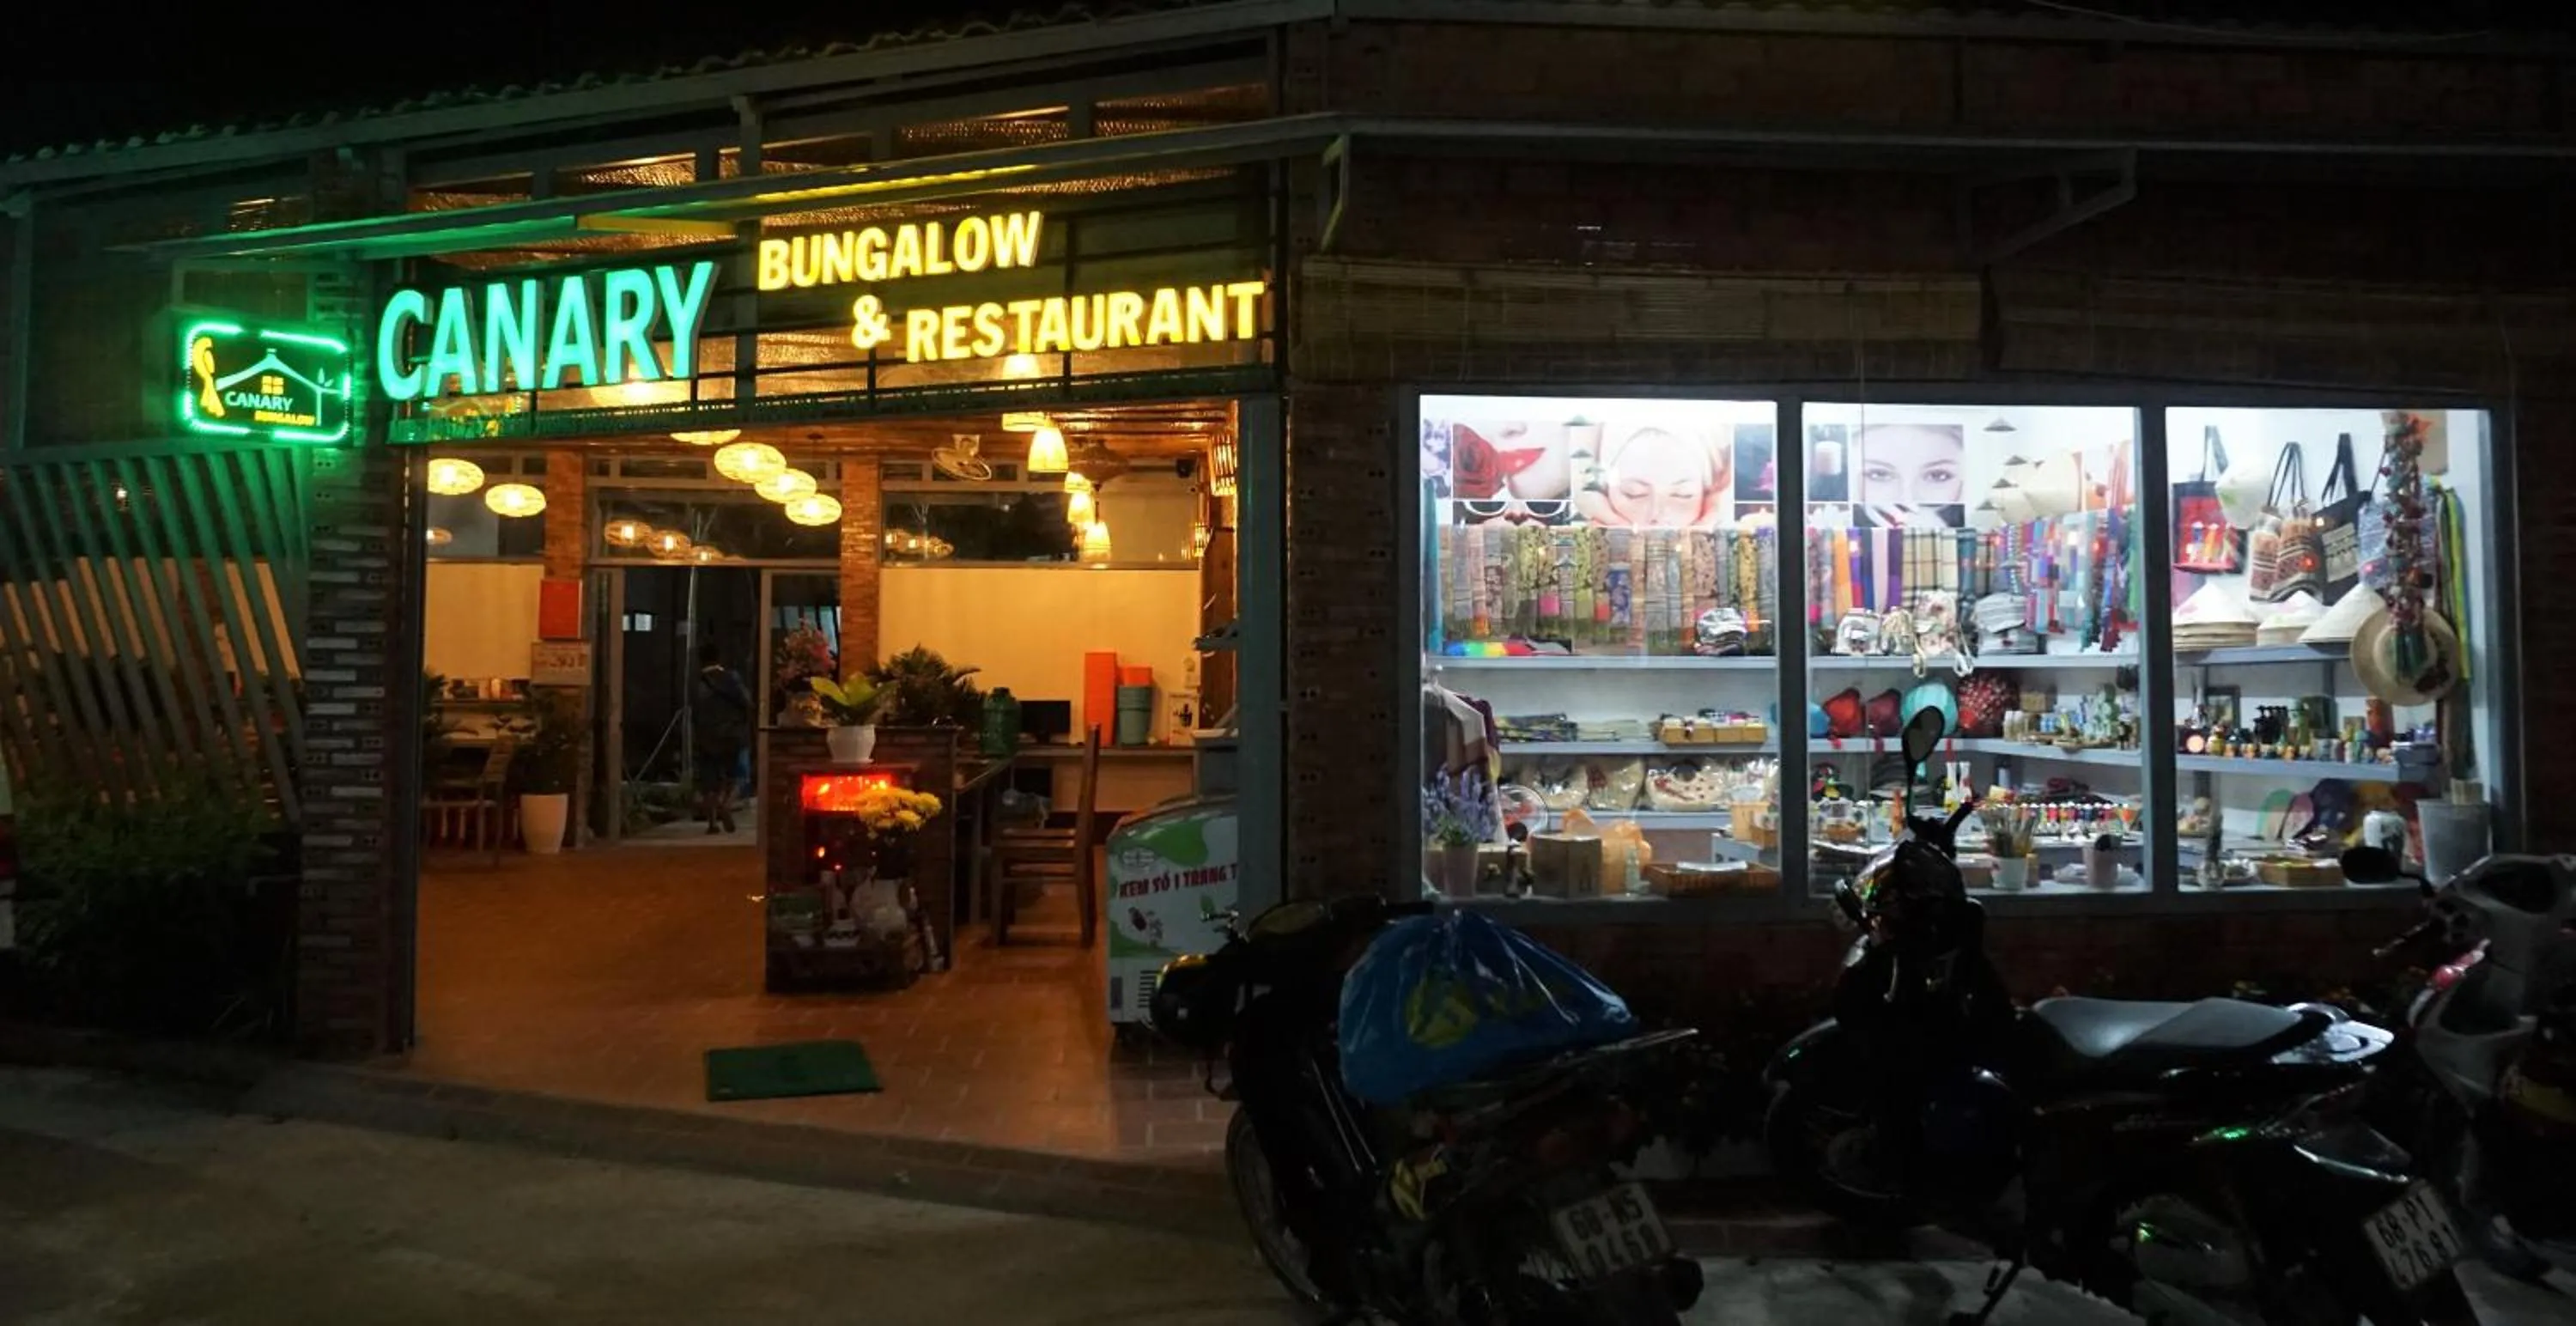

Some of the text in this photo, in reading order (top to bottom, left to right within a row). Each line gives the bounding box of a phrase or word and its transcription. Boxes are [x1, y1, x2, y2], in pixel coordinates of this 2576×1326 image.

[758, 211, 1042, 290] BUNGALOW
[378, 261, 714, 401] CANARY
[851, 281, 1265, 363] & RESTAURANT
[224, 391, 294, 411] CANARY
[254, 410, 315, 426] BUNGALOW
